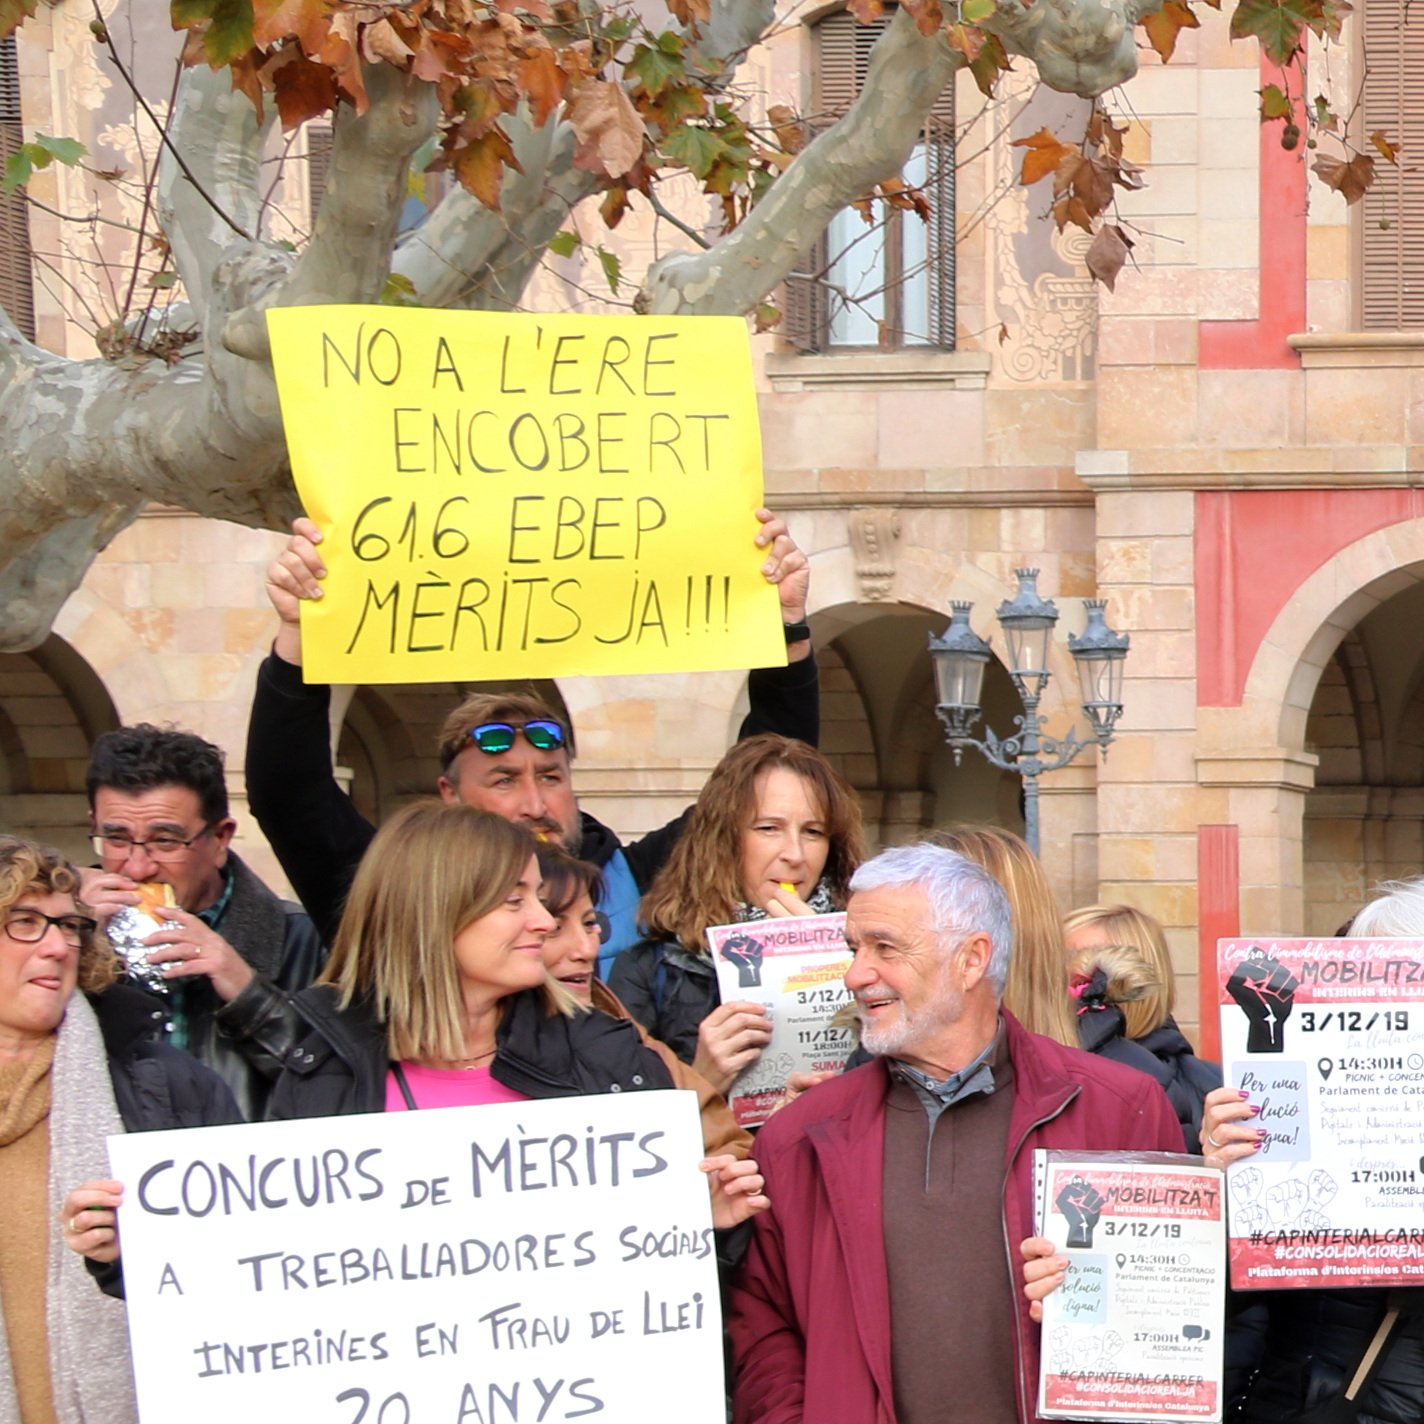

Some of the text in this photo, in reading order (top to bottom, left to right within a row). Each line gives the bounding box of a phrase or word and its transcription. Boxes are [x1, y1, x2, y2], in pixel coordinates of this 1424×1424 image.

[323, 322, 679, 396] NO A L'ERE
[394, 408, 729, 476] ENCOBERT
[351, 496, 666, 564] 61.6 EBEP
[346, 570, 582, 654] MÈRITS
[1312, 986, 1376, 998] INTERINS
[1380, 986, 1398, 997] EN
[1301, 1010, 1409, 1032] 3/12/19
[1338, 1057, 1403, 1071] 14:30H
[1319, 1086, 1381, 1096] Parlament
[1384, 1086, 1398, 1095] de
[137, 1124, 669, 1218] CONCURS DE MÈRITS
[1351, 1170, 1415, 1183] 17:00H
[1106, 1187, 1218, 1209] MOBILITZA'T
[1105, 1221, 1181, 1238] 3/12/19
[158, 1225, 716, 1295] A TREBALLADORES SOCIALS
[194, 1291, 704, 1378] INTERINES EN FRAU DE LLEI
[1060, 1369, 1204, 1388] #CAPINTERIALCARRER
